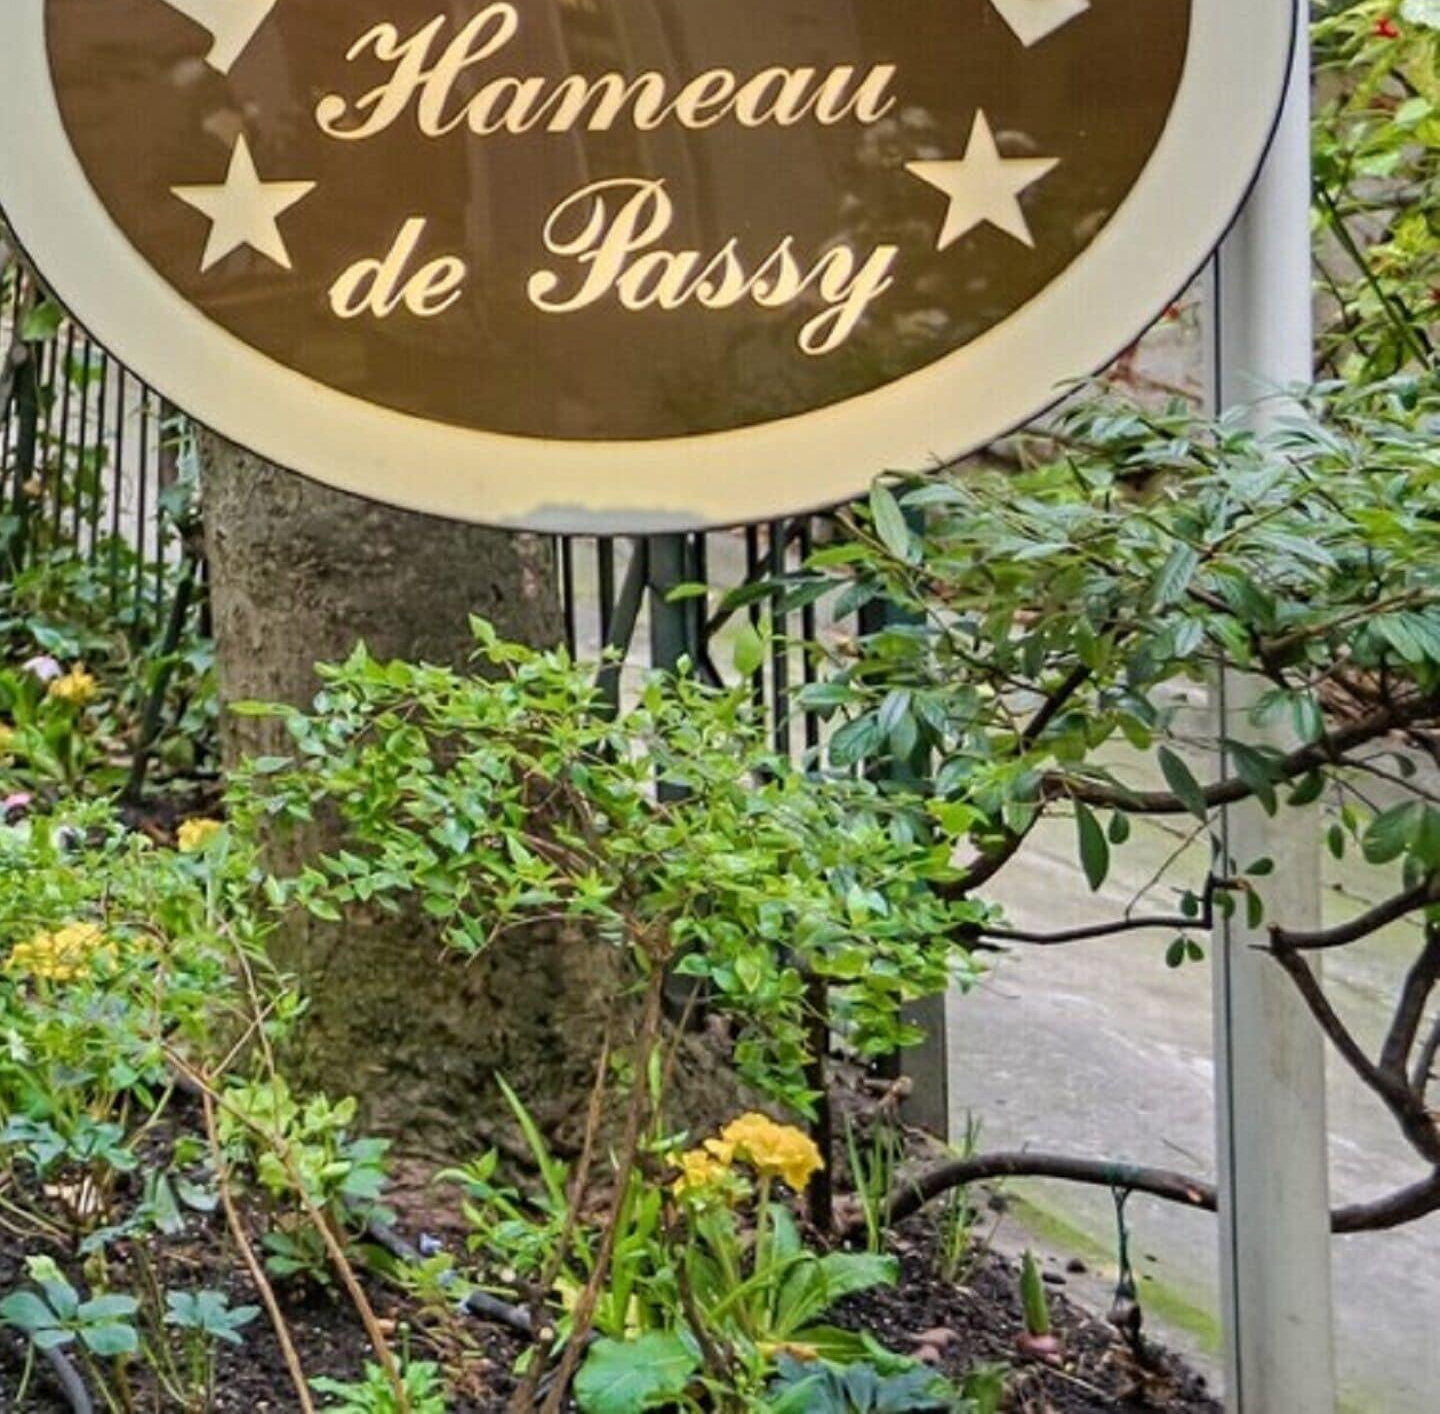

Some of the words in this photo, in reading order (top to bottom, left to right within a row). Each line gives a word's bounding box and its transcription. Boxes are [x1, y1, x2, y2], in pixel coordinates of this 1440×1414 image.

[314, 0, 897, 140] Hameau
[327, 216, 465, 320] de
[526, 177, 901, 356] Passy
